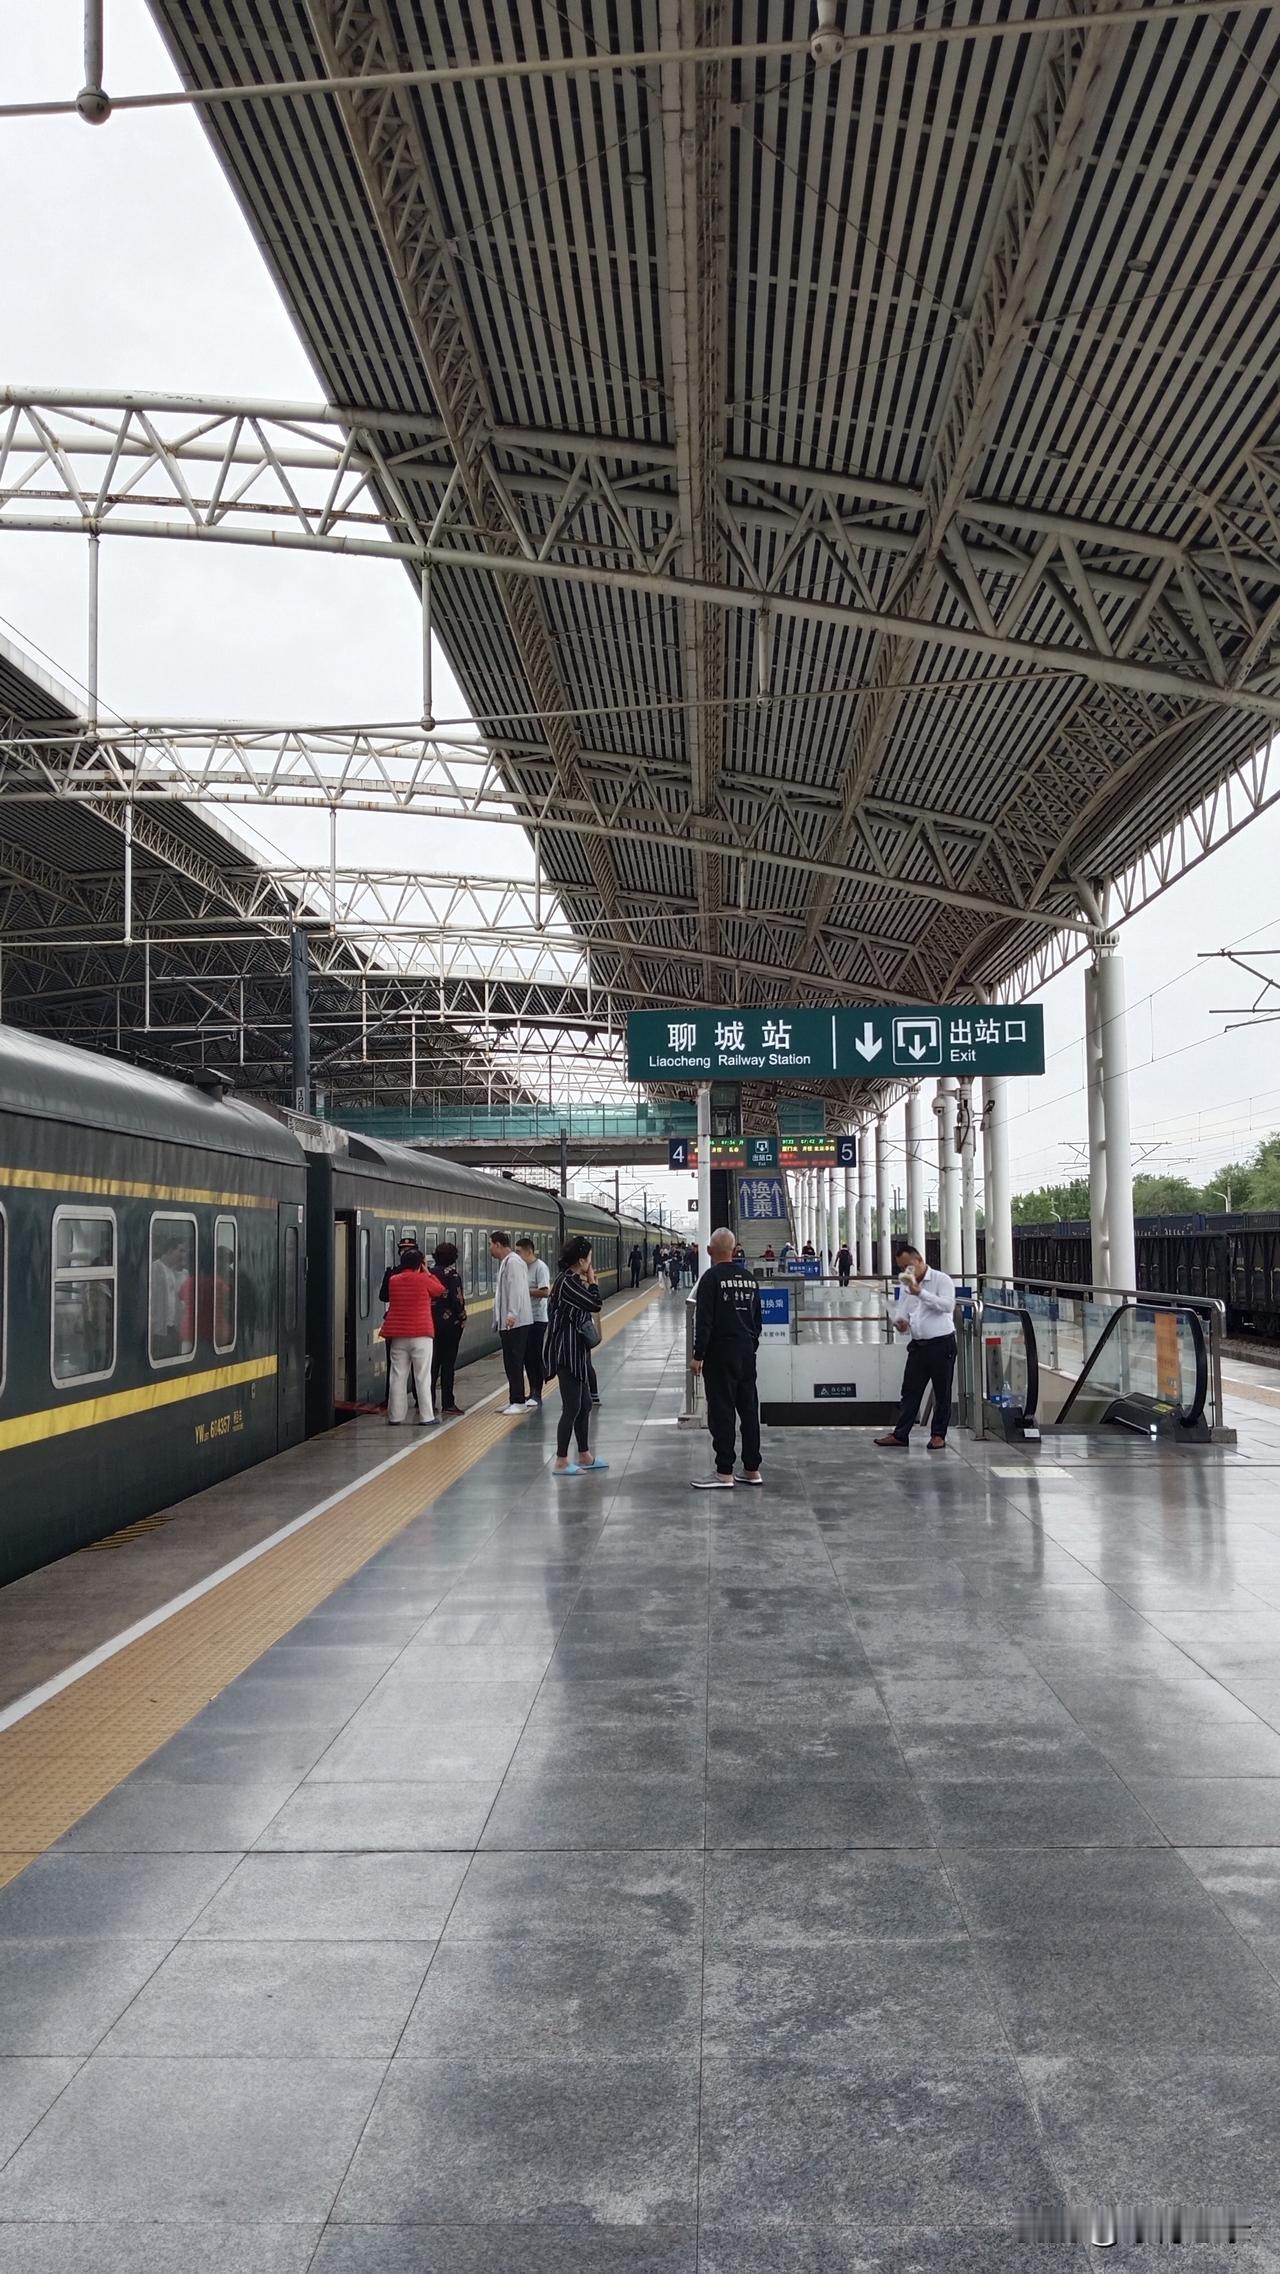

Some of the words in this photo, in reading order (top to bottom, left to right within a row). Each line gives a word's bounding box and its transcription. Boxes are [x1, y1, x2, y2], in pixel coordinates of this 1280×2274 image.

[667, 1019, 792, 1052] 聊城站
[949, 1018, 1027, 1045] 出站口
[649, 1055, 711, 1068] Liaocheng
[718, 1054, 765, 1068] Railway
[768, 1053, 811, 1066] Station
[949, 1048, 976, 1062] Exit
[672, 1146, 685, 1163] 4
[752, 1154, 773, 1162] 出站口
[841, 1143, 853, 1161] 5
[690, 1201, 697, 1210] 4
[751, 1181, 773, 1217] 换乘
